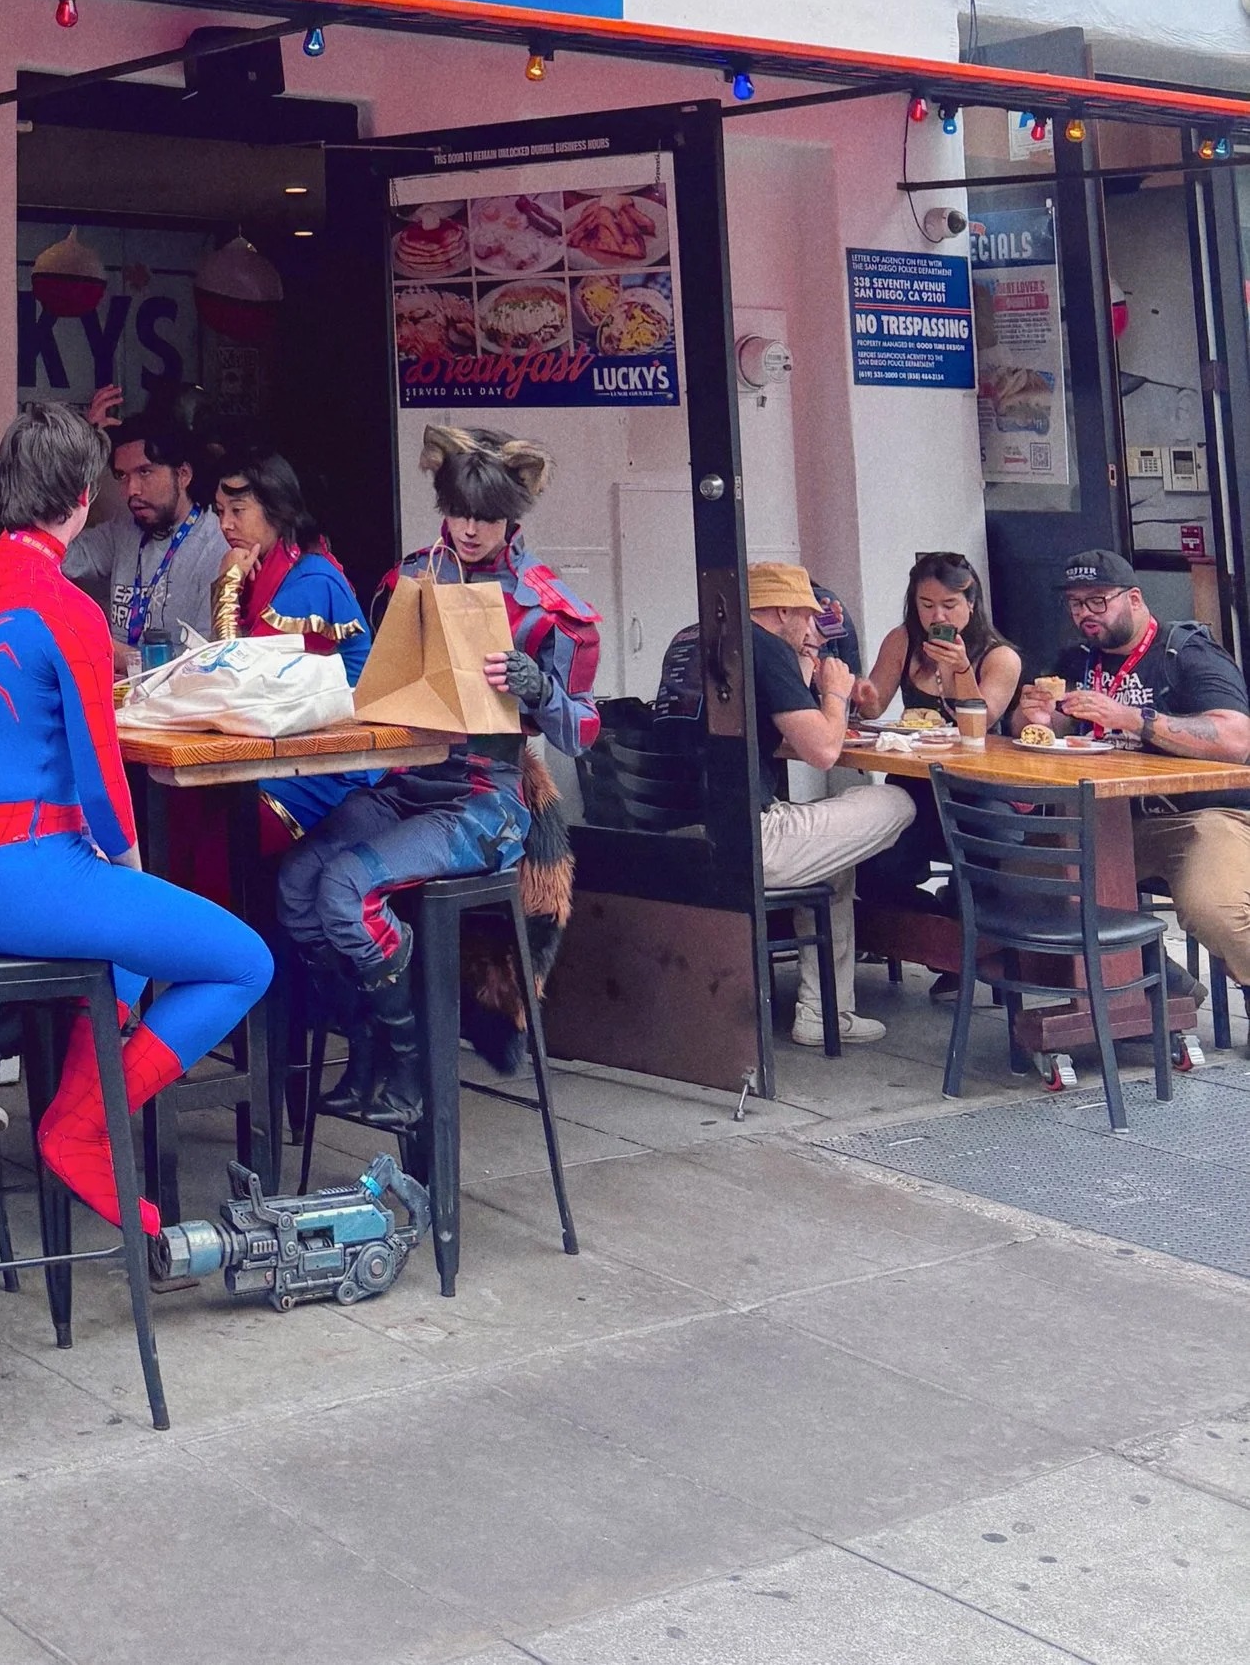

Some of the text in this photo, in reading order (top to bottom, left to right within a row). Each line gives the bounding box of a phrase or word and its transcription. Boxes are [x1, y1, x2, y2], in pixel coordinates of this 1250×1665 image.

[434, 138, 610, 165] THIS DOOR TO REMAIN UNLOCKED DURING BUSINESS HOURS
[852, 254, 870, 263] LETTER
[871, 255, 880, 263] OF
[881, 256, 905, 265] AGENCY
[906, 258, 916, 266] ON
[928, 259, 942, 267] WITH
[864, 263, 877, 271] SAN
[878, 264, 897, 273] DIEGO
[898, 266, 917, 274] POLICE
[918, 267, 952, 276] DEPARTMENT
[853, 276, 946, 292] 338 SEVENTH AVENUE
[854, 288, 946, 303] SAN DIEGO, CA 92101
[855, 313, 877, 334] NO
[880, 315, 969, 339] TRESPASSING
[857, 339, 881, 347] PROPERTY
[882, 340, 907, 348] MANAGED
[857, 351, 876, 359] REPORT
[877, 352, 906, 360] SUSPICIOUS
[907, 353, 927, 361] ACTIVITY
[935, 354, 943, 362] THE
[858, 358, 869, 366] SAN
[405, 340, 596, 400] Breakfast
[405, 386, 502, 397] SERVED ALL DAY
